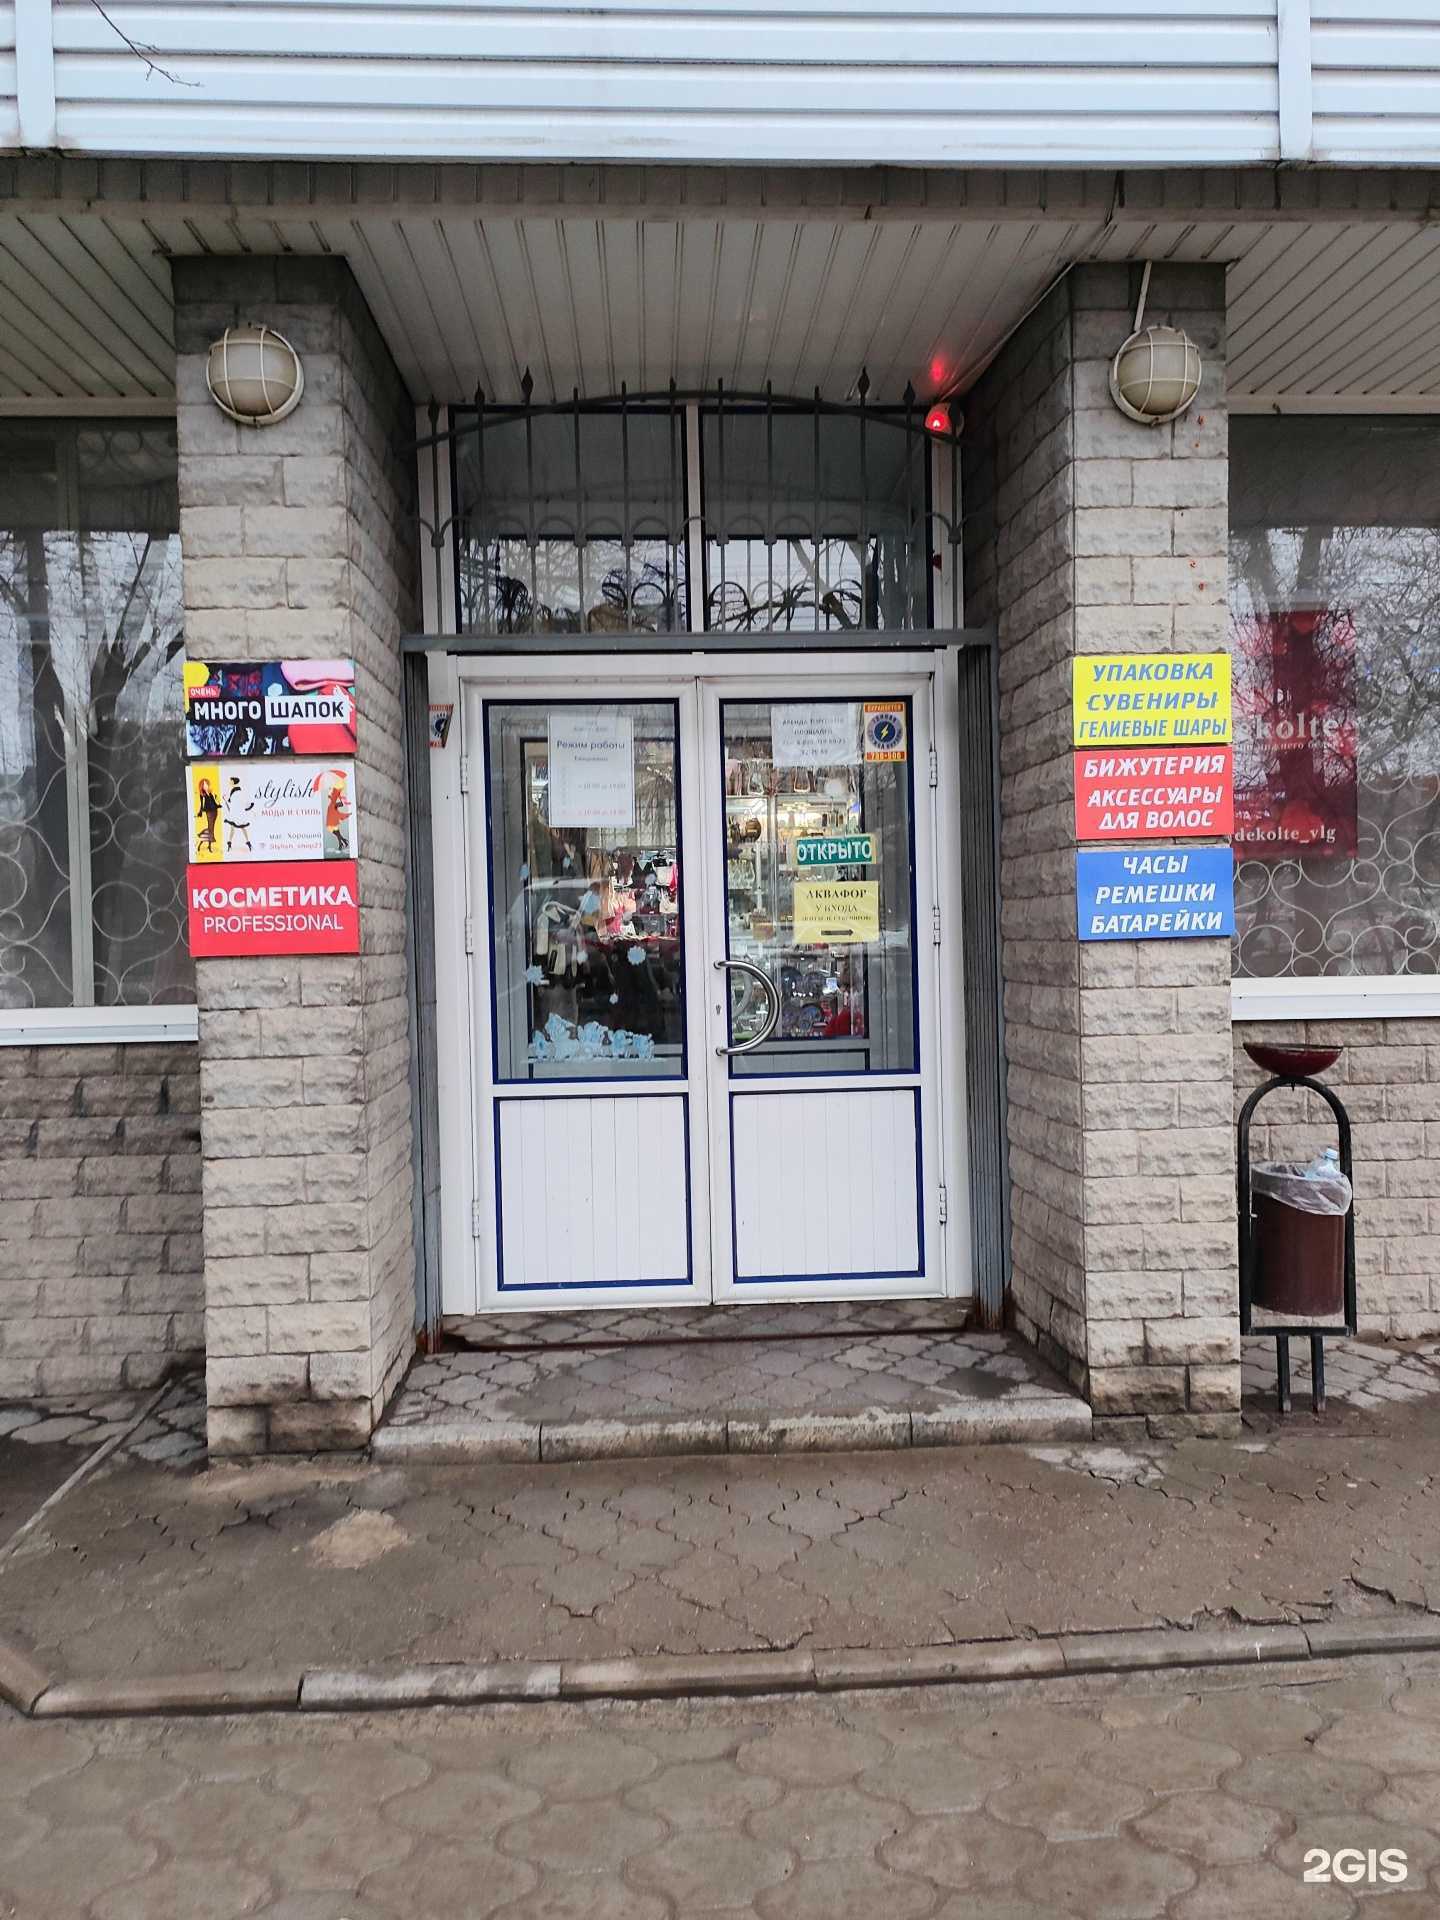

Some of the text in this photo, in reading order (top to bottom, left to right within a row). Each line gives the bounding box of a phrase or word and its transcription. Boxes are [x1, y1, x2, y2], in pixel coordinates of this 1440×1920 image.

[1093, 663, 1213, 682] УПАКОВКА
[190, 688, 216, 697] ОЧЕНЬ
[1087, 692, 1218, 711] СУВЕНИРЫ
[194, 701, 344, 721] МНОГО ШАПОК
[1079, 718, 1226, 738] ГЕЛИЕВЫЕ ШАРЫ
[1237, 712, 1339, 740] ekolte
[1084, 755, 1226, 778] БИЖУТЕРИЯ
[254, 778, 313, 808] stylish
[1087, 786, 1223, 807] АКСЕССУАРЫ
[1099, 812, 1139, 830] ДЛЯ
[1145, 809, 1214, 829] ВОЛОС
[796, 840, 873, 862] ОТКРЫТО
[1123, 855, 1188, 875] ЧАСЫ
[192, 886, 354, 911] КОСМЕТИКА
[806, 889, 867, 899] АКВАФОР
[1095, 883, 1216, 905] РЕМЕШКИ
[204, 913, 343, 933] PROFESSIONAL
[1090, 910, 1223, 934] БАТАРЕЙКИ
